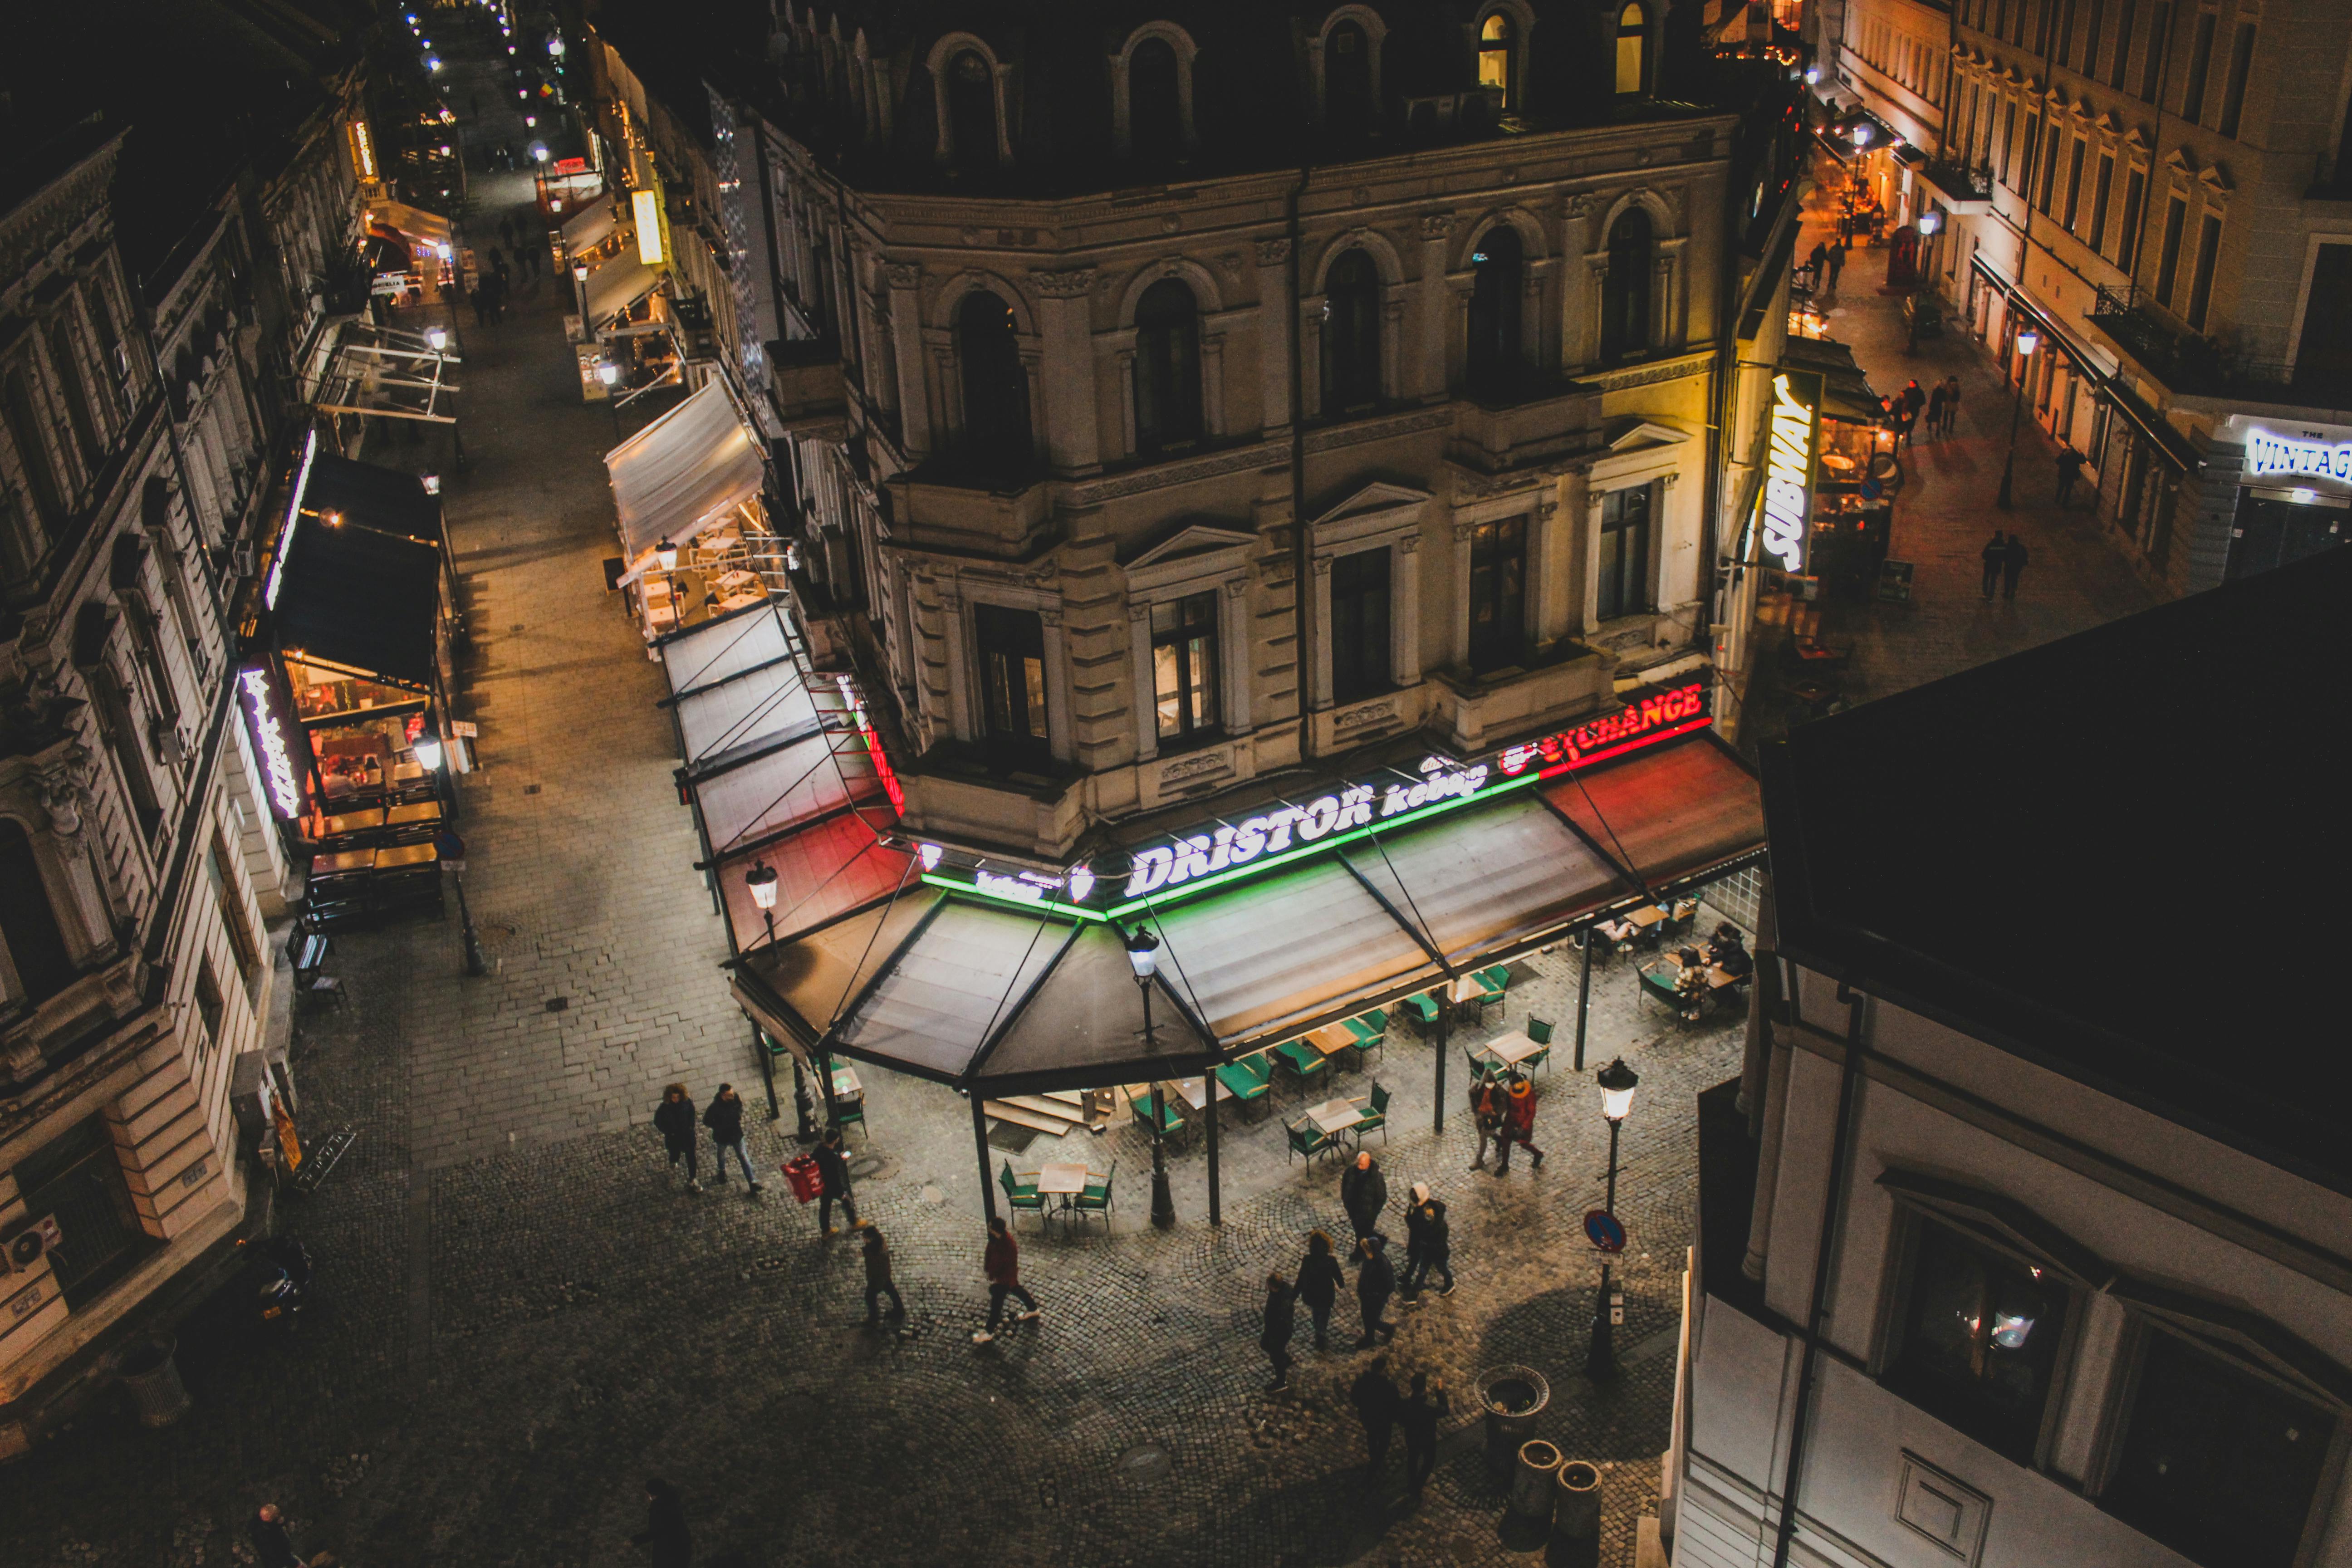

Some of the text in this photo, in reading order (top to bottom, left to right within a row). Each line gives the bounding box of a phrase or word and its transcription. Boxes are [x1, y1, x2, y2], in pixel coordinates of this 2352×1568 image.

[1763, 373, 1813, 573] SUBWAY
[2255, 438, 2352, 481] VINTAG
[241, 669, 300, 819] KILKENNY
[1540, 683, 1702, 763] EXCHANGE
[1124, 784, 1374, 898] DRISTOR
